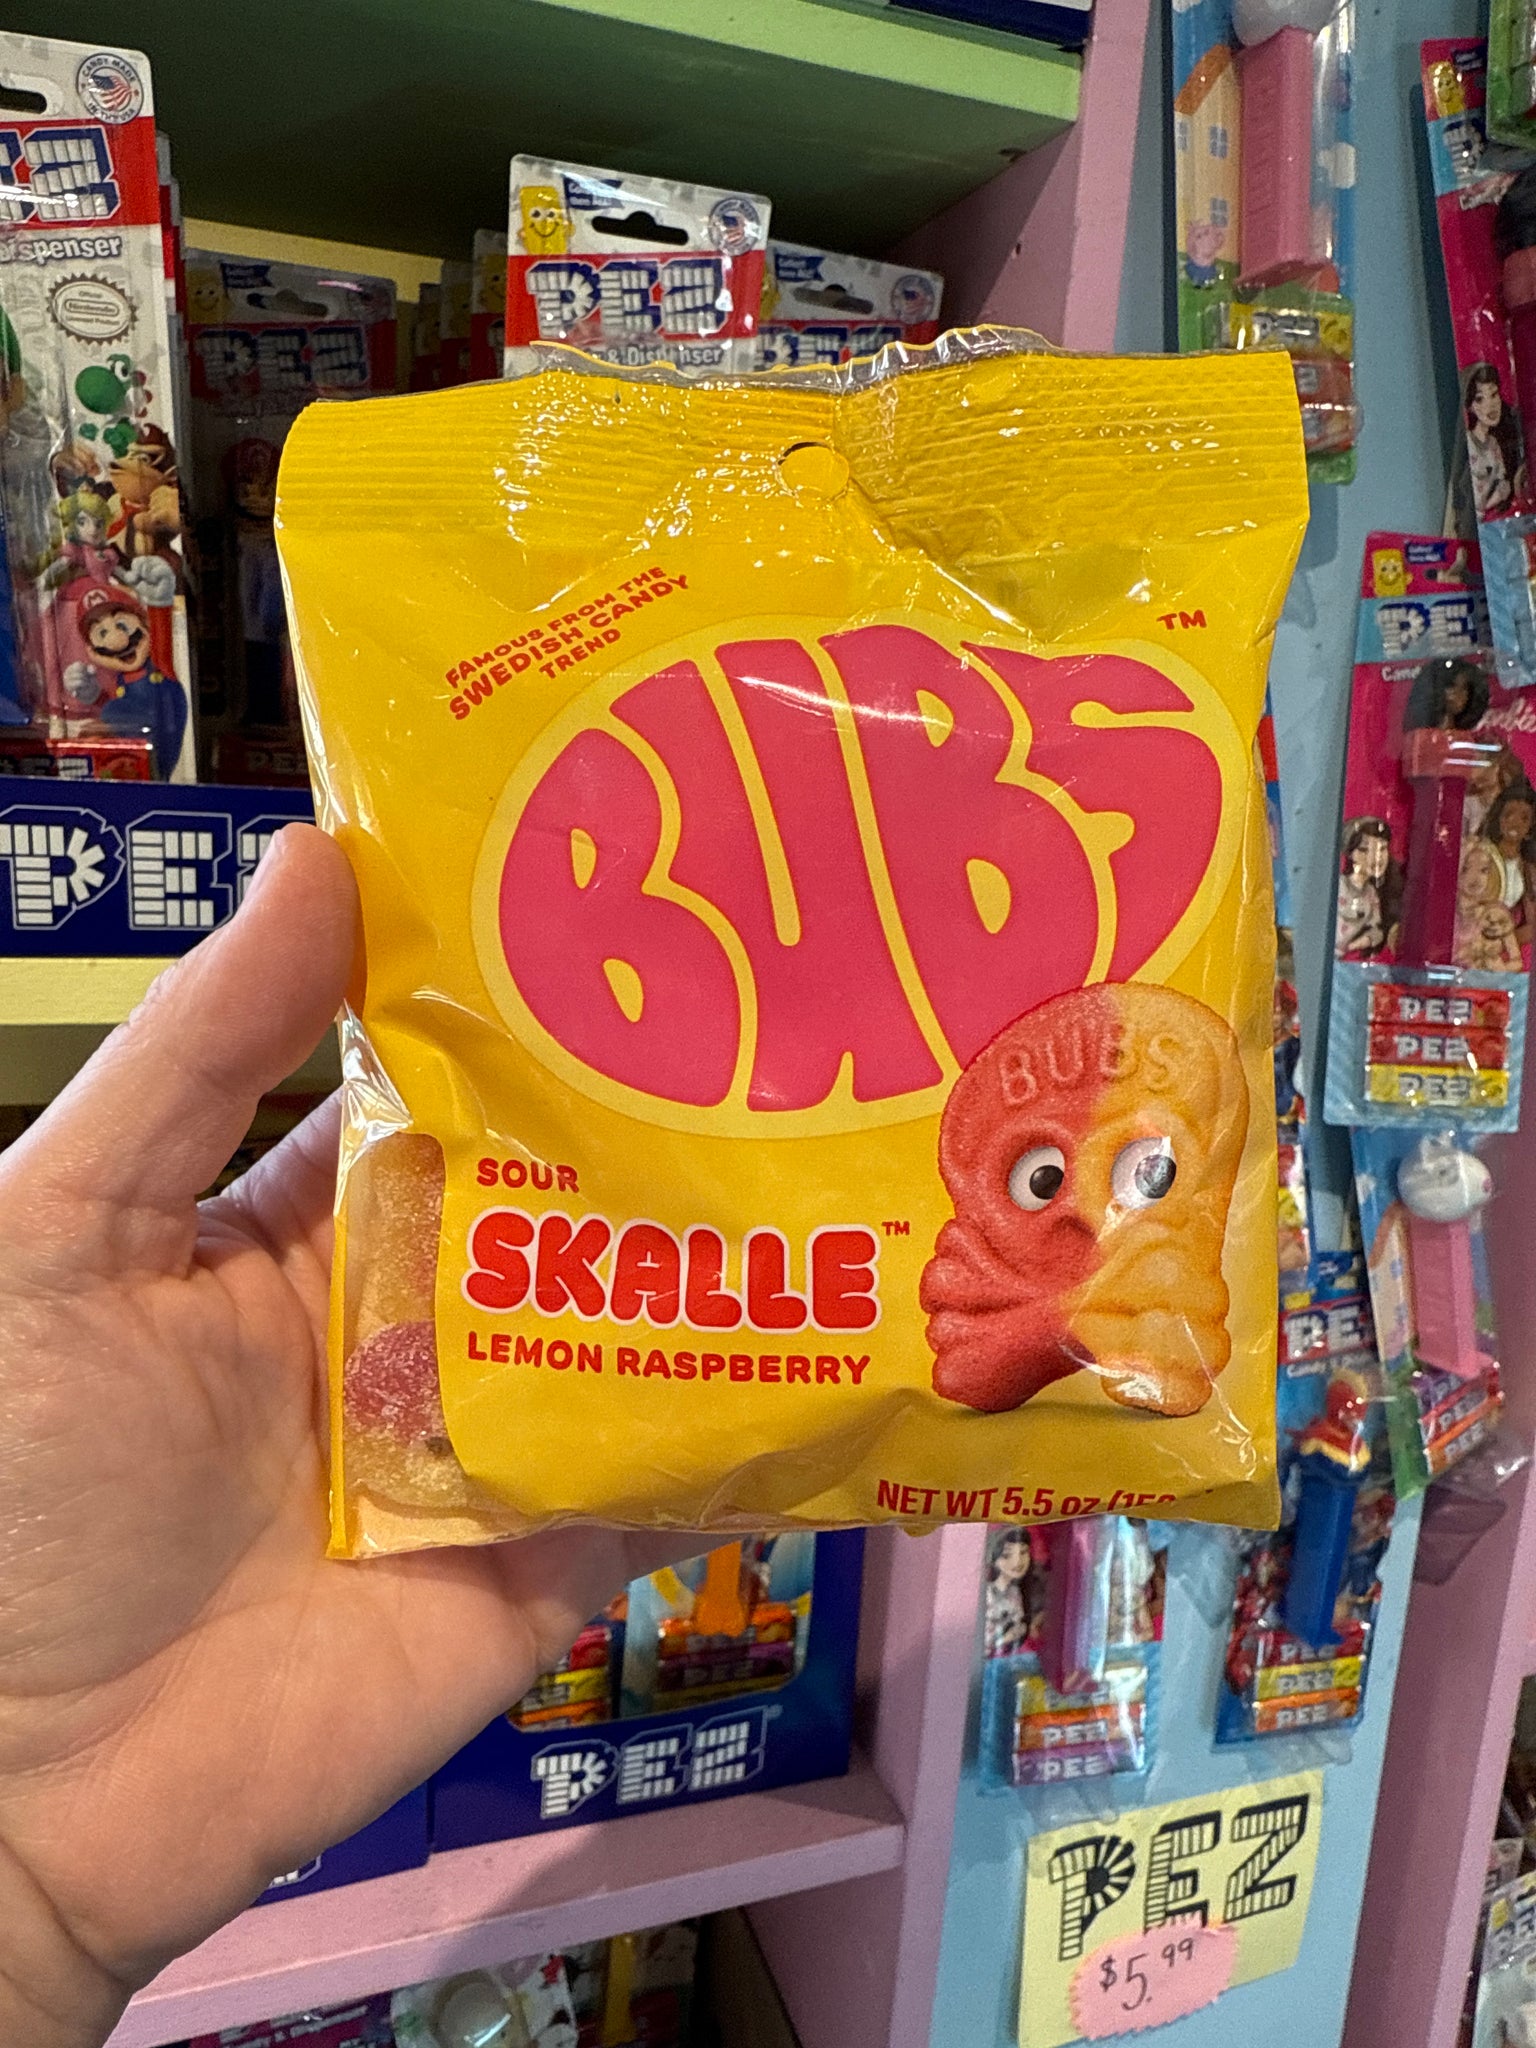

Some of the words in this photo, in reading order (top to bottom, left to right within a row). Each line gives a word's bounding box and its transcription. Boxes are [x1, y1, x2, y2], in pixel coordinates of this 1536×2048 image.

[526, 257, 729, 339] PEZ
[446, 628, 545, 689] FAMOUS
[547, 592, 617, 632] FROM
[618, 566, 667, 593] THE
[449, 626, 584, 721] SWEDISH
[589, 573, 690, 628] CANDY
[538, 628, 622, 680] TREND
[1157, 609, 1207, 632] TM
[499, 624, 1223, 1112] BUBS
[1393, 1034, 1471, 1063] PEZ
[1398, 995, 1472, 1024] PEZ
[999, 1020, 1176, 1107] BUBS
[475, 1157, 580, 1194] SOUR
[461, 1205, 883, 1335] SKALLE
[882, 1220, 910, 1237] TM
[467, 1331, 603, 1375] LEMON
[616, 1346, 871, 1386] RASPBERRY
[877, 1478, 941, 1516] NET
[945, 1486, 999, 1519] WT
[1001, 1486, 1056, 1517] 5.5
[1060, 1495, 1102, 1516] oz
[531, 1706, 766, 1820] PEZ
[1047, 1793, 1310, 1962] PEZ
[1099, 1937, 1196, 2012] $5.99
